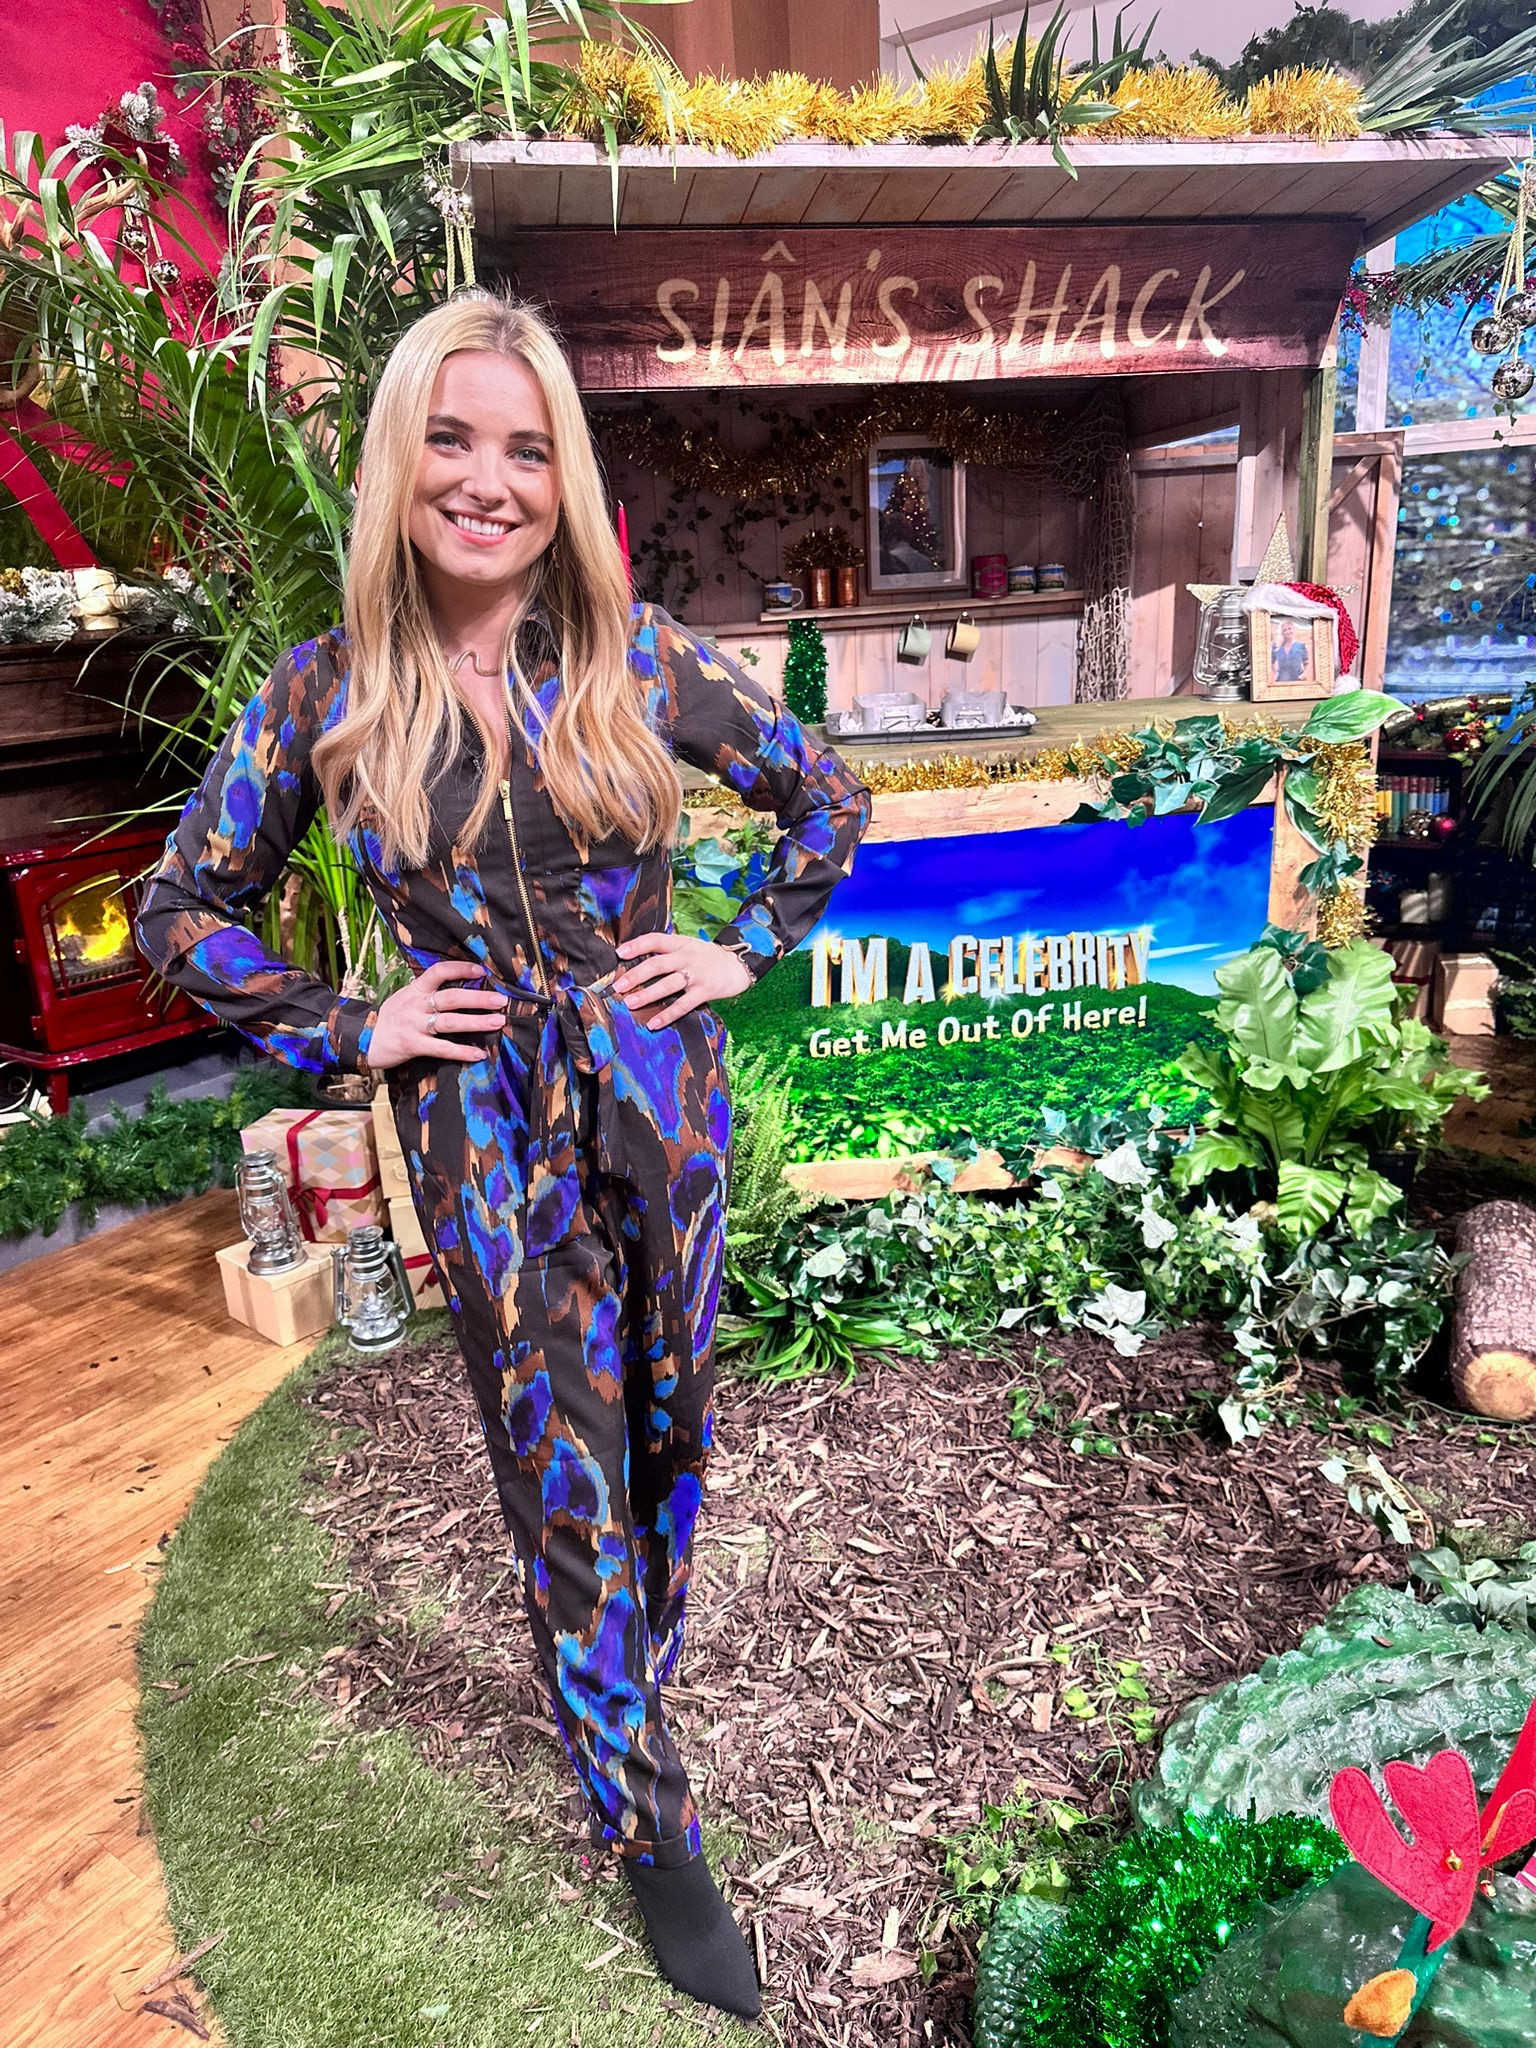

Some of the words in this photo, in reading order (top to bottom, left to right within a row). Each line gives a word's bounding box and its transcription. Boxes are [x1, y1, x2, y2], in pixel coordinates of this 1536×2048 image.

[656, 241, 919, 366] SIÂN'S
[954, 260, 1245, 358] SHACK
[811, 936, 889, 1008] I'M
[903, 942, 936, 1006] A
[950, 930, 1152, 997] CELEBRITY
[809, 1029, 871, 1058] Get
[881, 1020, 927, 1051] Me
[938, 1017, 1001, 1046] Out
[1011, 1004, 1055, 1039] Of
[1062, 995, 1148, 1033] Here!
